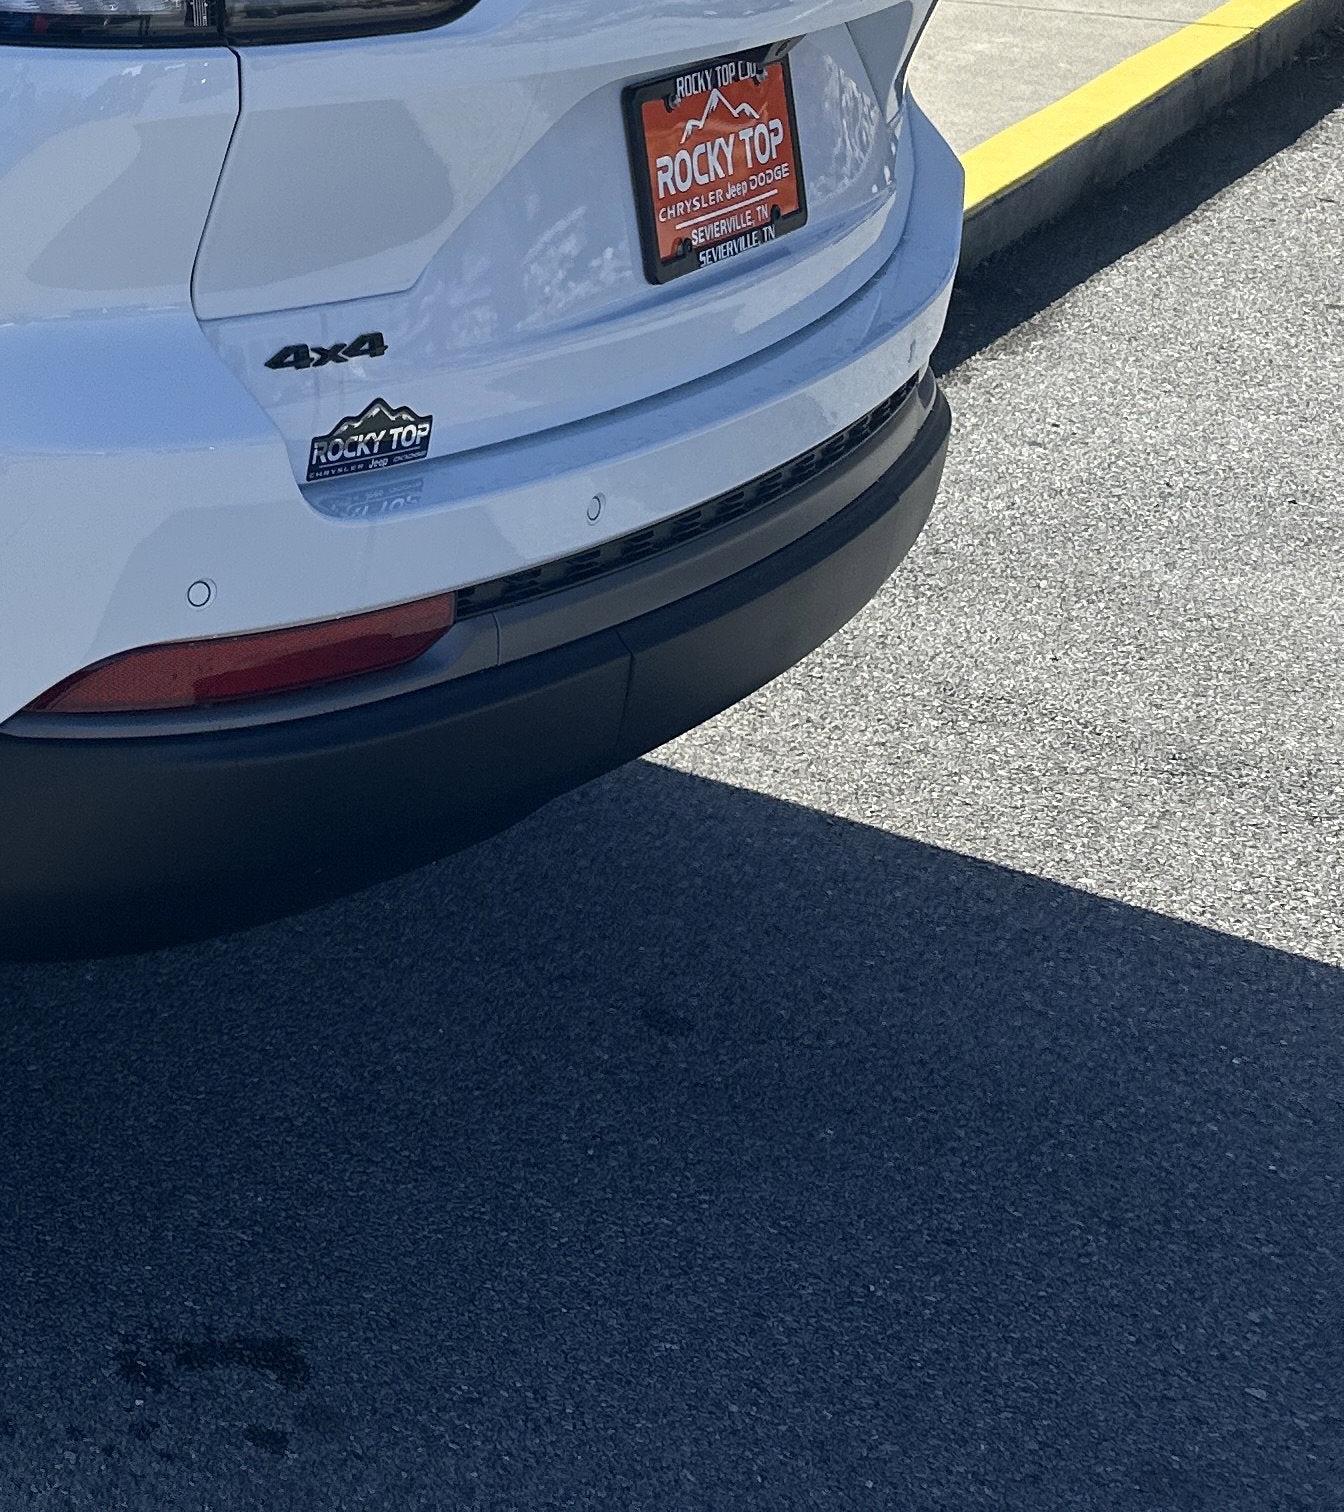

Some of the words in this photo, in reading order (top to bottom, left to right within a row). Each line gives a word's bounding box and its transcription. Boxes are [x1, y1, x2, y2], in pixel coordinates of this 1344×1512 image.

[676, 68, 713, 99] ROCKY
[715, 62, 736, 88] TOP
[656, 133, 735, 199] ROCKY
[739, 118, 783, 168] TOP
[658, 188, 723, 223] CHRYSLER
[726, 180, 748, 199] Jeep
[749, 162, 790, 190] DODGE
[691, 209, 755, 246] SEVIERVILLE,
[756, 203, 769, 223] TN
[762, 225, 776, 246] TN
[264, 332, 388, 369] 4x4
[311, 429, 387, 465] ROCKY
[389, 423, 430, 450] TOP
